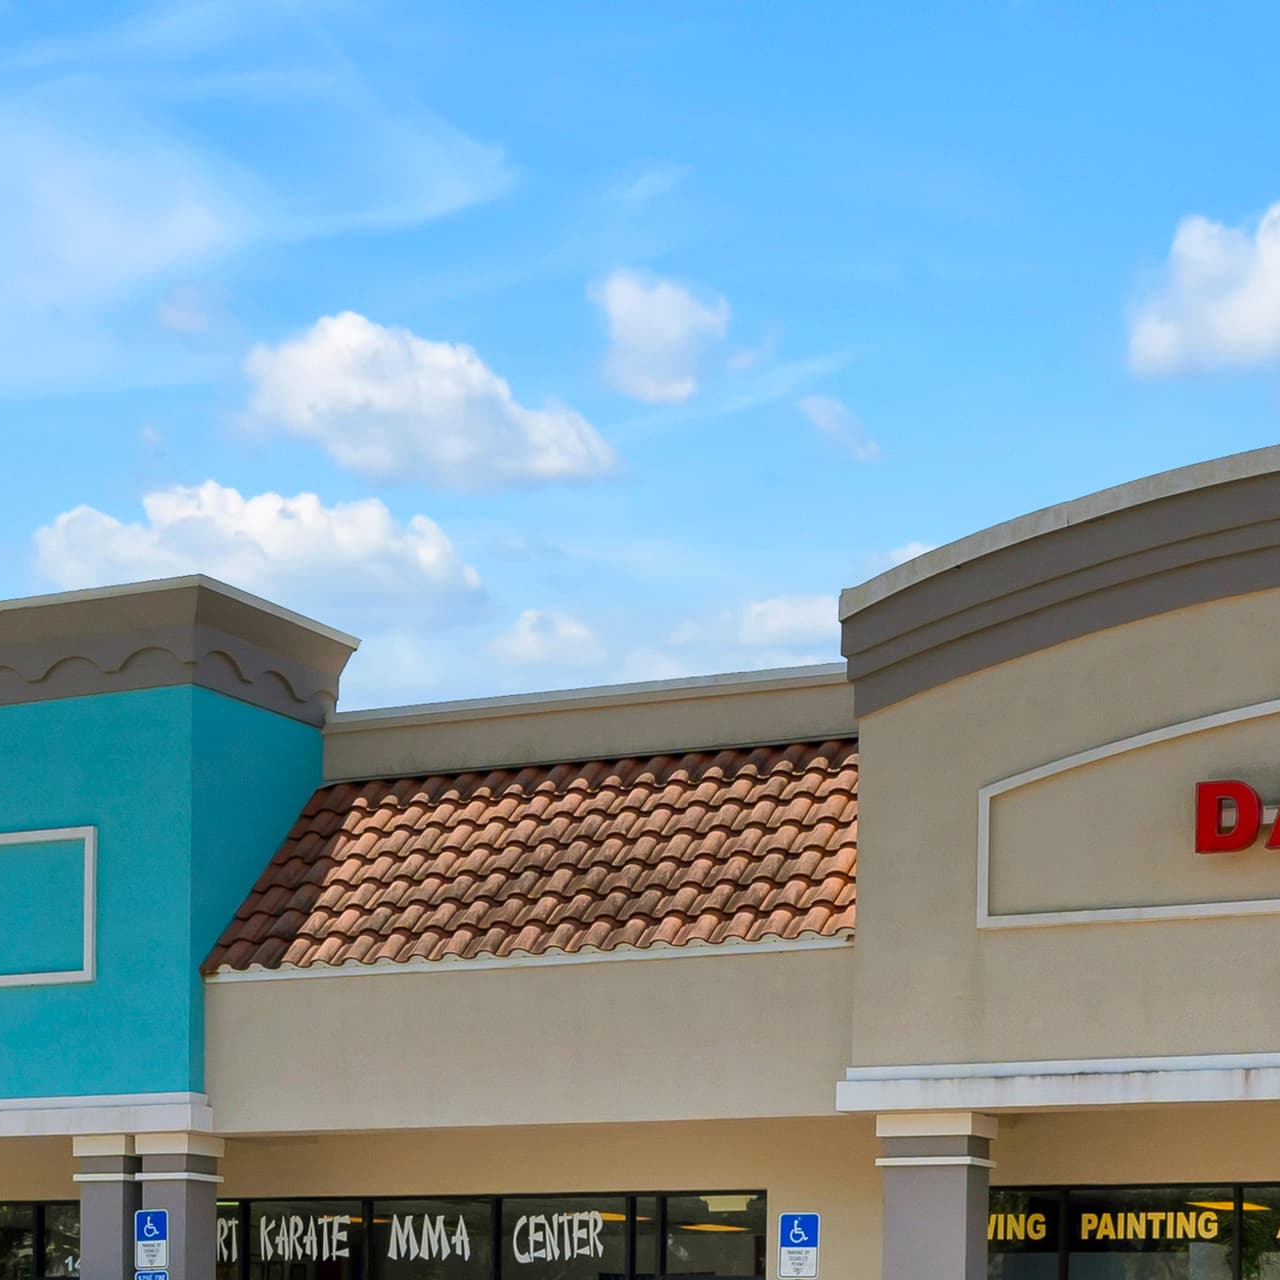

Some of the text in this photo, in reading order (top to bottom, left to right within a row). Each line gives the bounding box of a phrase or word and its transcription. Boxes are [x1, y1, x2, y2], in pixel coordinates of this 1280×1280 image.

[216, 1217, 239, 1263] RT
[259, 1215, 351, 1263] KARATE
[387, 1213, 471, 1262] MMA
[512, 1211, 605, 1264] CENTER
[1080, 1211, 1218, 1240] PAINTING
